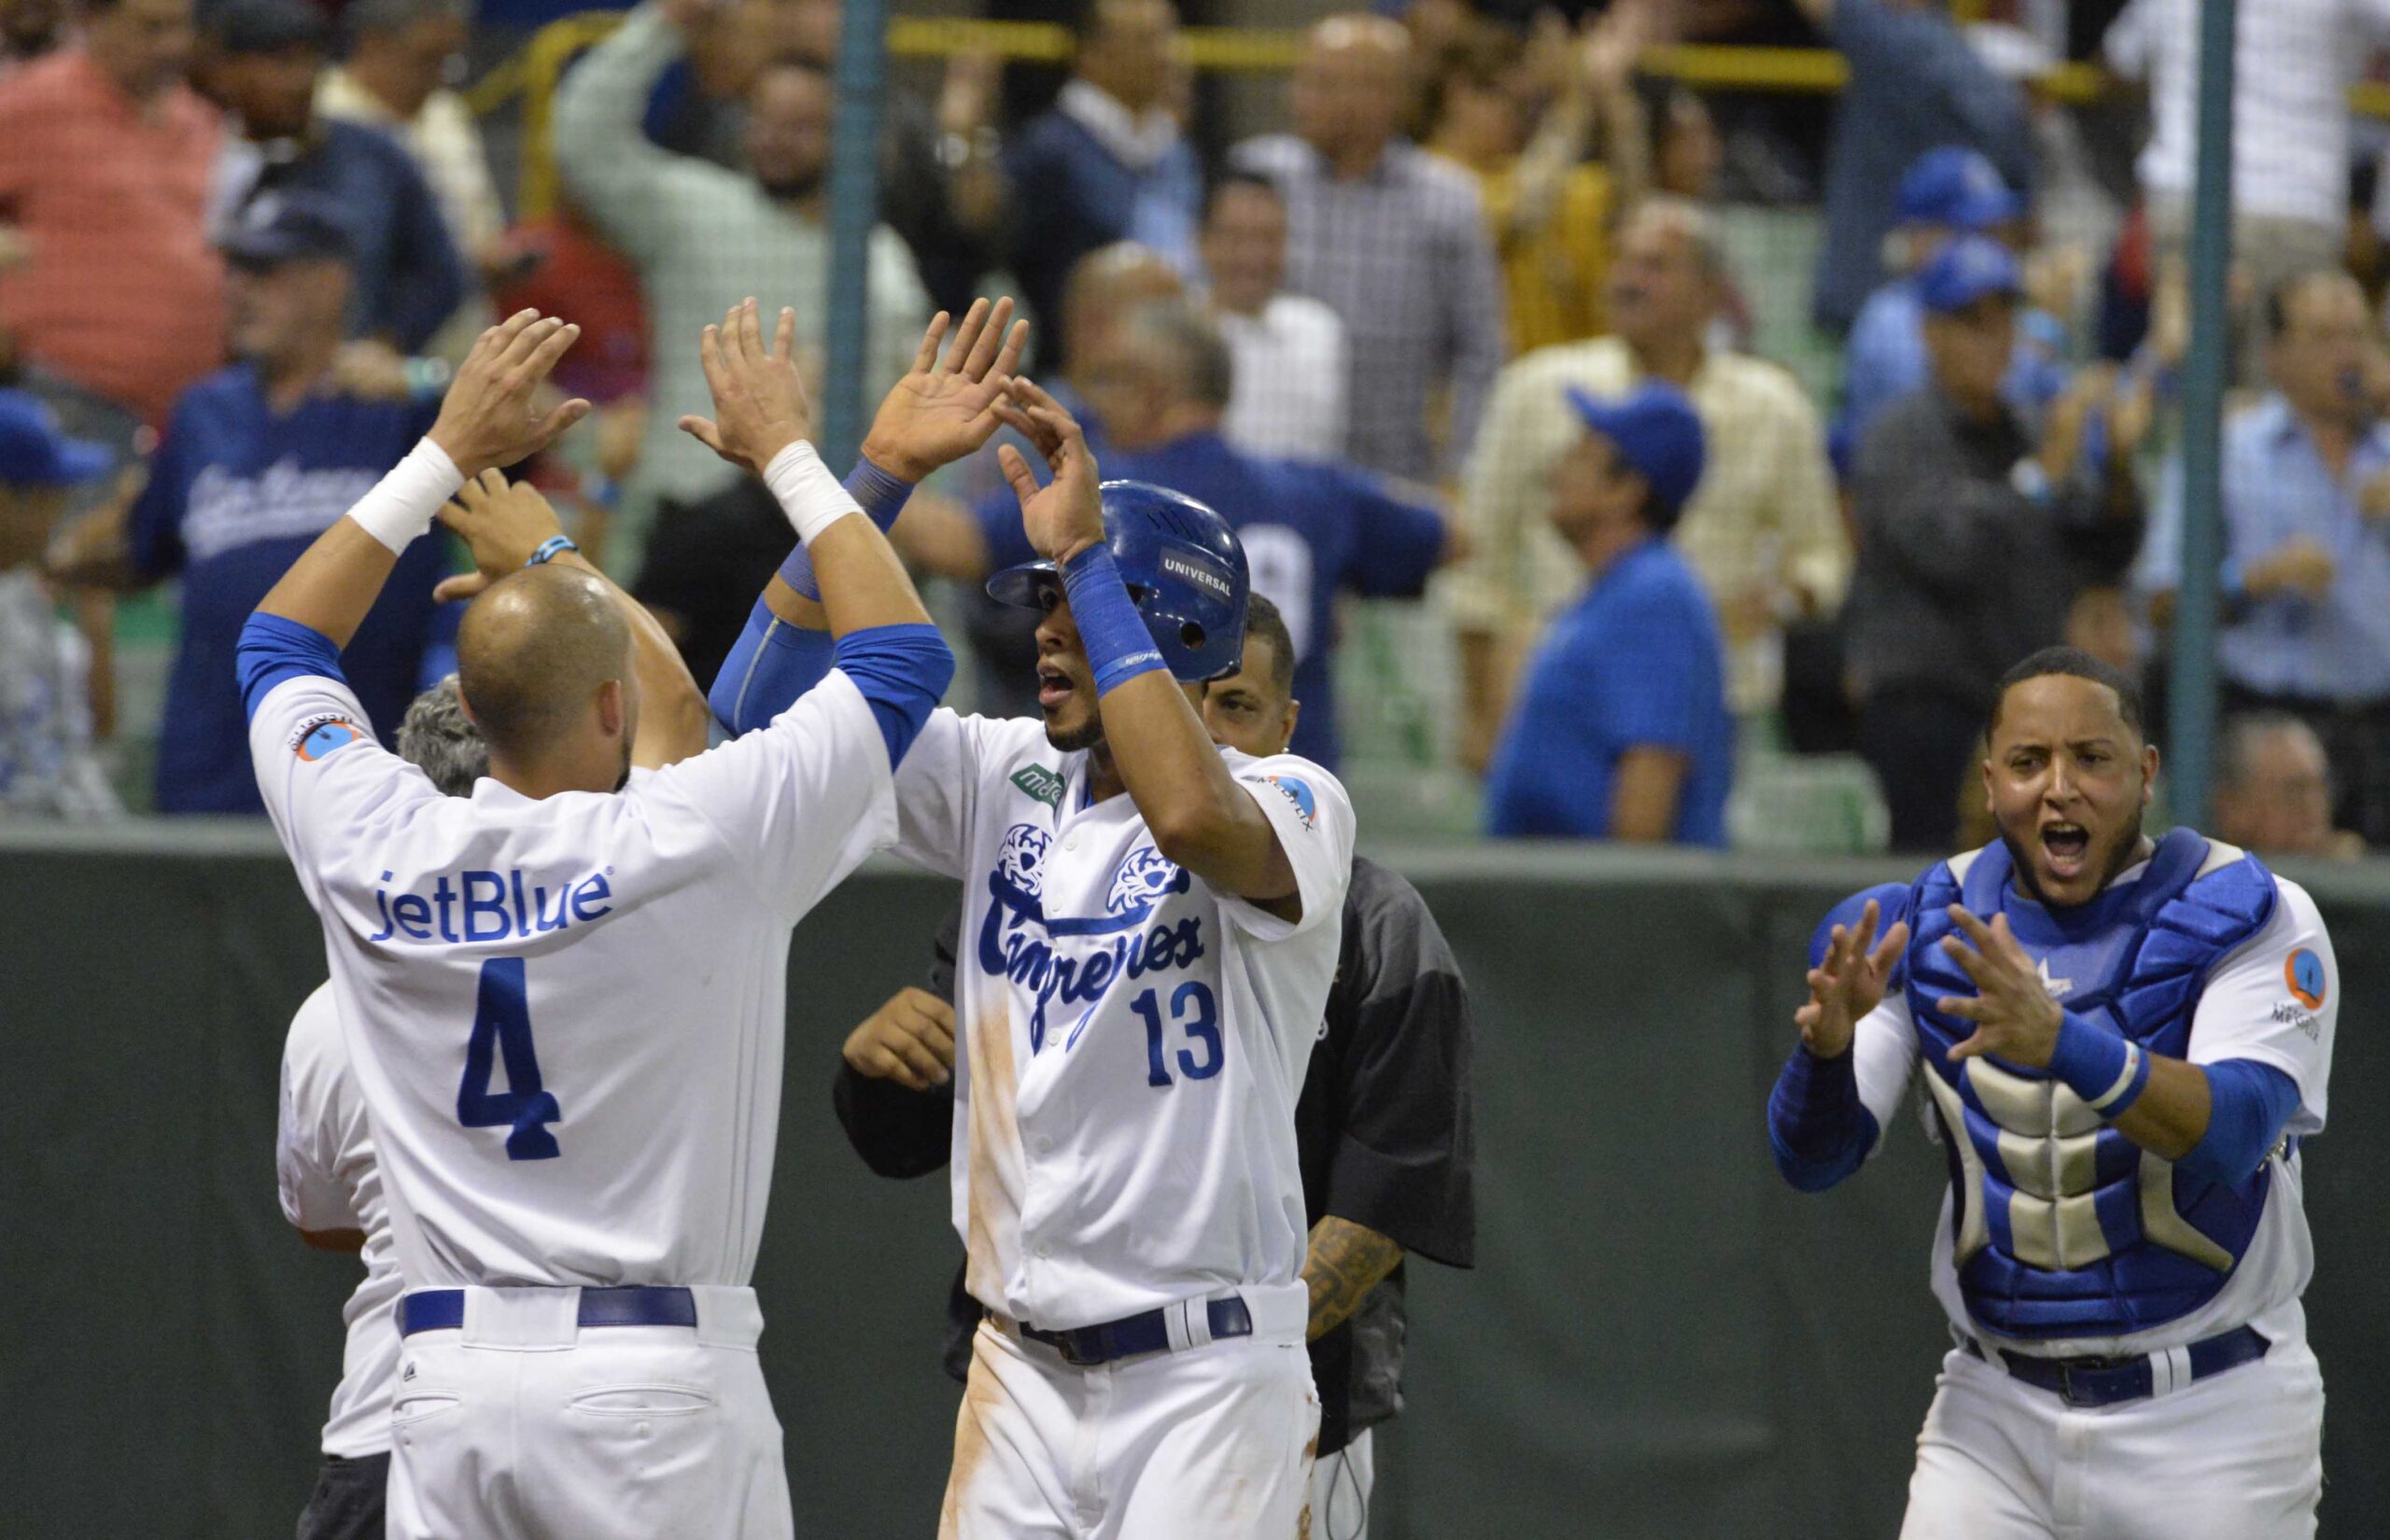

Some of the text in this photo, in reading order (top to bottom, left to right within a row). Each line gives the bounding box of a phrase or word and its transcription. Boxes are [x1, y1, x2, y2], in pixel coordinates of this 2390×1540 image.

[1164, 557, 1231, 597] UNIVERSAL
[371, 869, 613, 943] jetBlue
[457, 957, 561, 1160] 4
[1130, 980, 1225, 1087] 13
